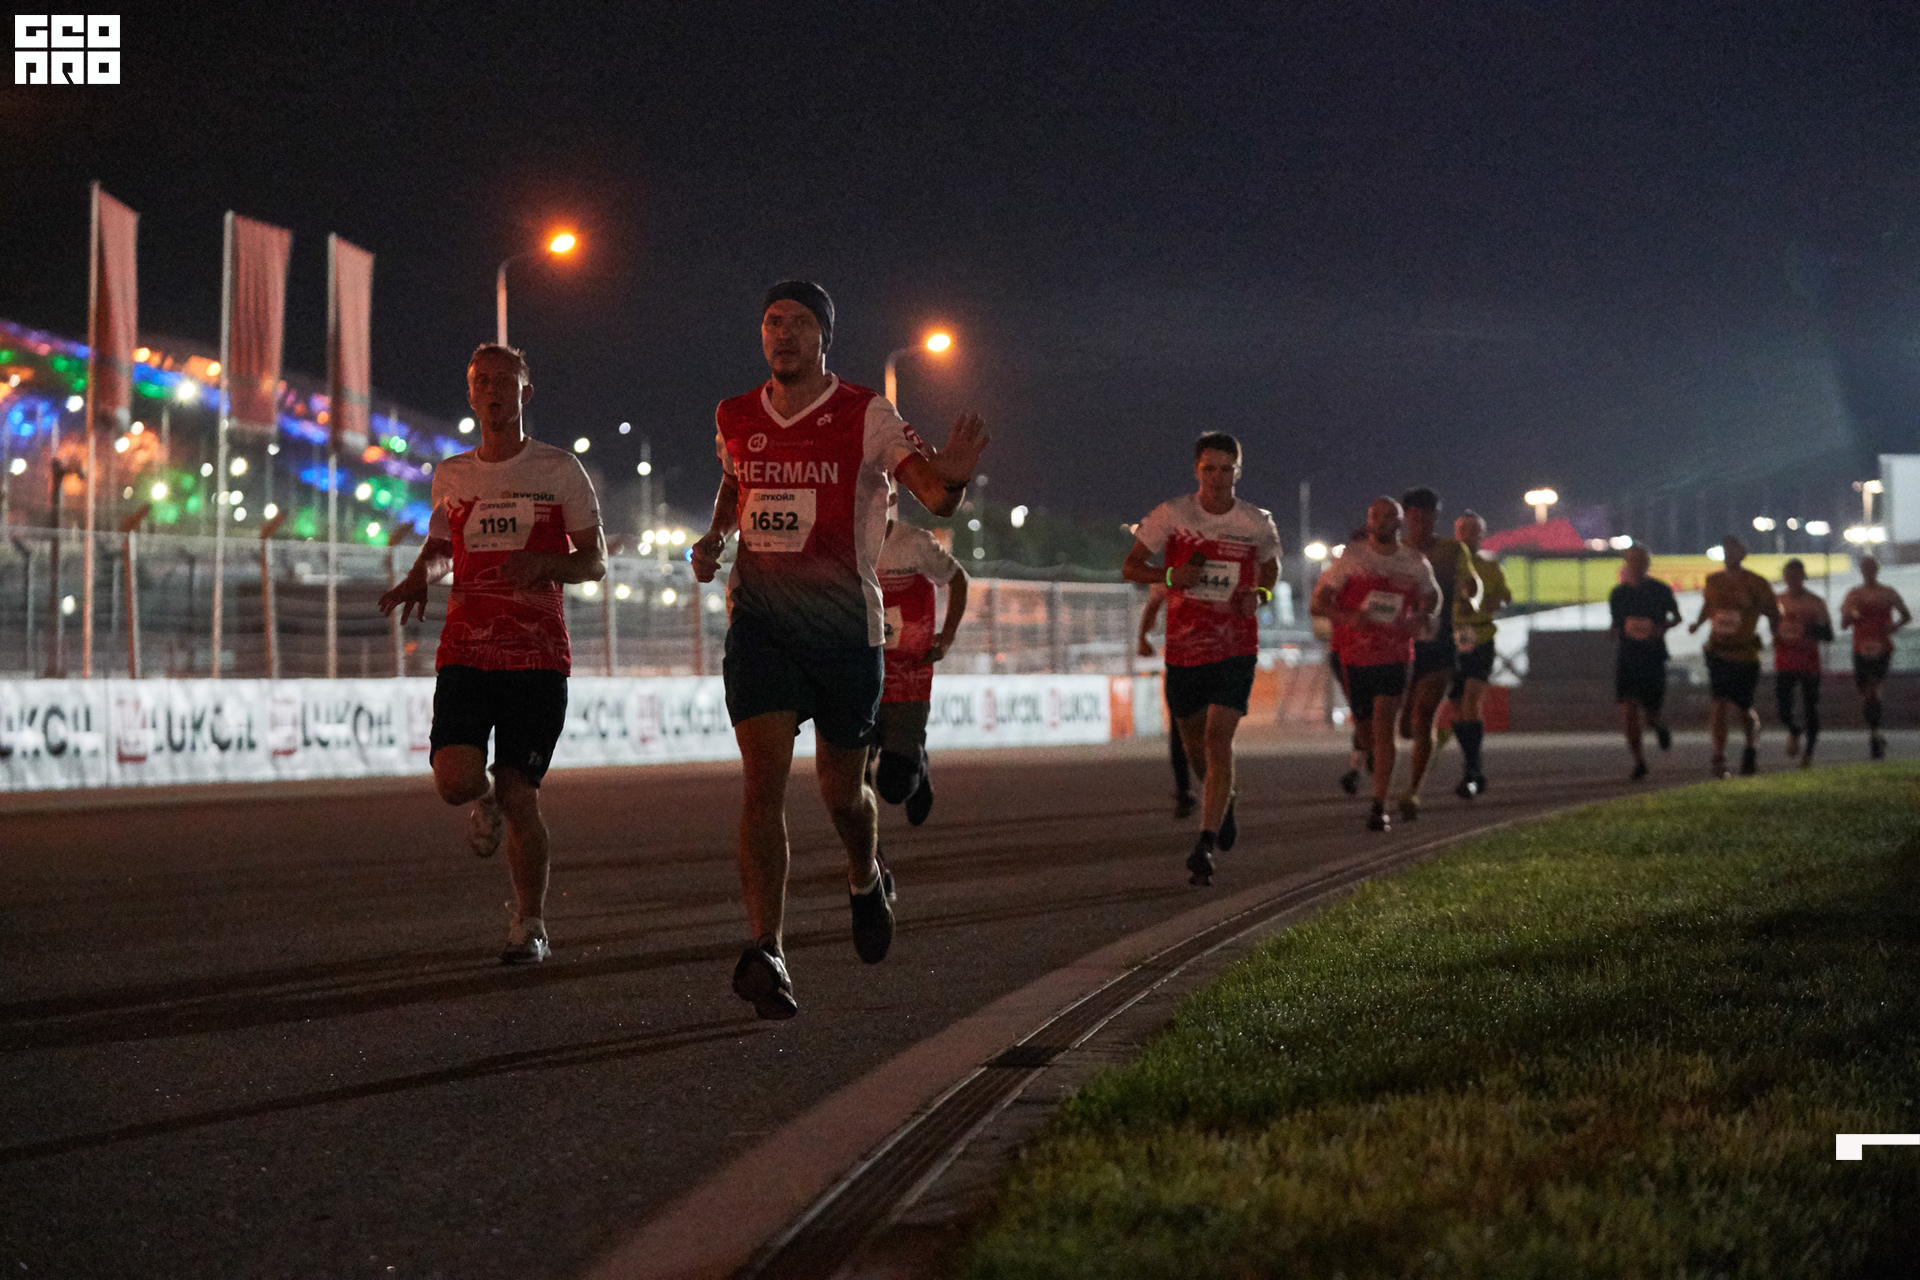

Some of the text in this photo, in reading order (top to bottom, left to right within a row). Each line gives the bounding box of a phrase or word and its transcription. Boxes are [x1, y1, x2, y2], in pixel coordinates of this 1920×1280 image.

[760, 493, 795, 501] ЛУКОЙЛ
[479, 516, 517, 534] 1191
[750, 511, 799, 531] 1652
[1199, 575, 1229, 587] 444
